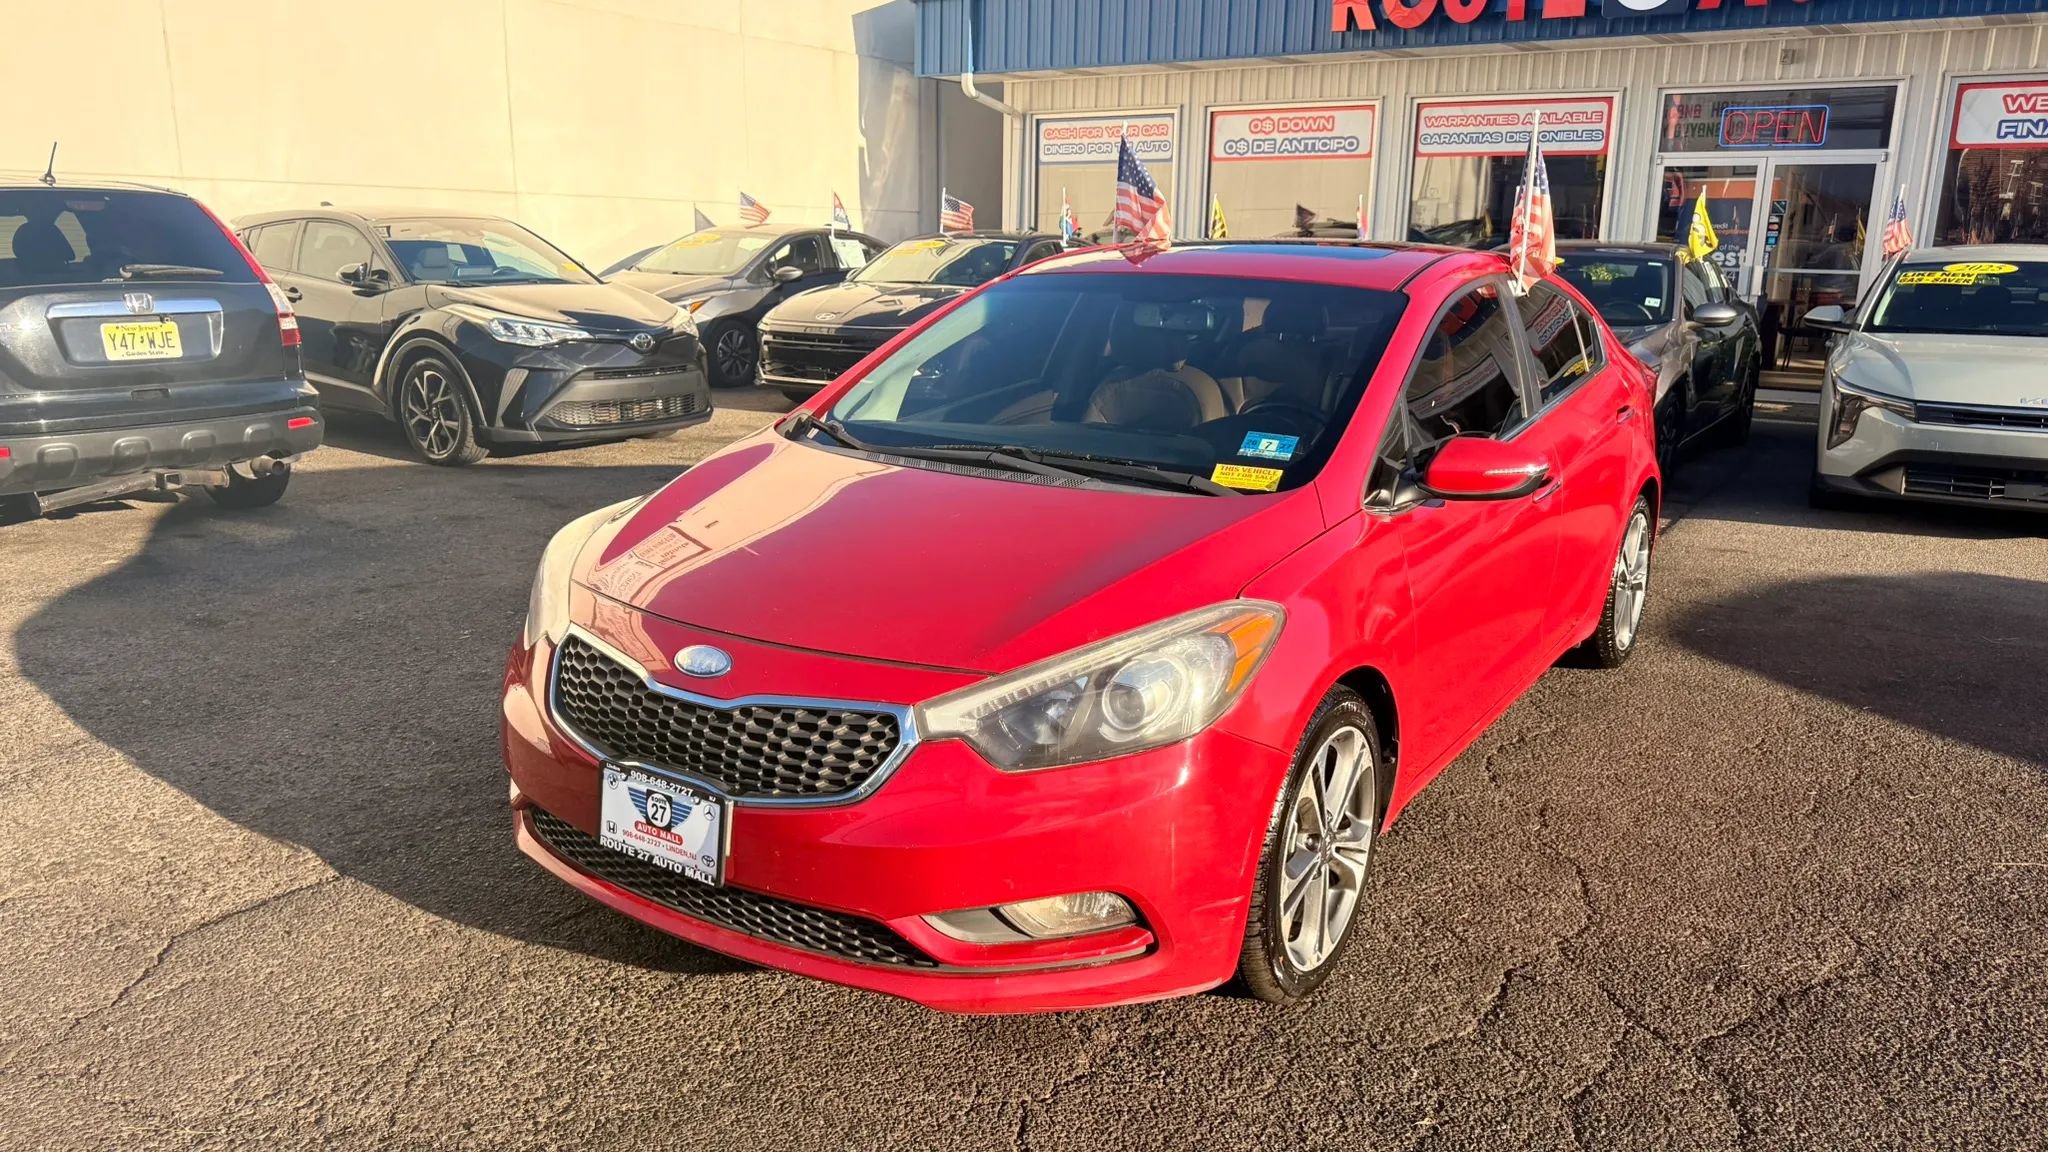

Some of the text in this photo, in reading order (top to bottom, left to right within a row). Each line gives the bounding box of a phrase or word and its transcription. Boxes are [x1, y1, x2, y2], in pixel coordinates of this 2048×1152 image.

[1278, 116, 1335, 132] DOWN
[1424, 111, 1603, 129] WARRANTIES AAILABLE
[1724, 111, 1825, 144] OPEN
[1997, 119, 2048, 139] FIN
[1044, 127, 1077, 140] CASH
[1079, 126, 1103, 138] FOR
[1141, 124, 1169, 136] CAR
[1420, 129, 1605, 145] GARANTIAS DISONIBLES
[1044, 143, 1085, 155] DINERO
[1087, 142, 1112, 154] POR
[1136, 140, 1171, 152] AUTO
[1252, 138, 1277, 154] DE
[1278, 136, 1359, 153] ANTICIPO
[1264, 441, 1273, 450] 7
[1220, 465, 1279, 477] THIS VEHICLE
[630, 770, 694, 797] 908-648-2727
[651, 803, 667, 823] 27
[637, 823, 681, 843] AUTO MALL
[600, 835, 715, 886] ROUTE 27 AUTO MALL
